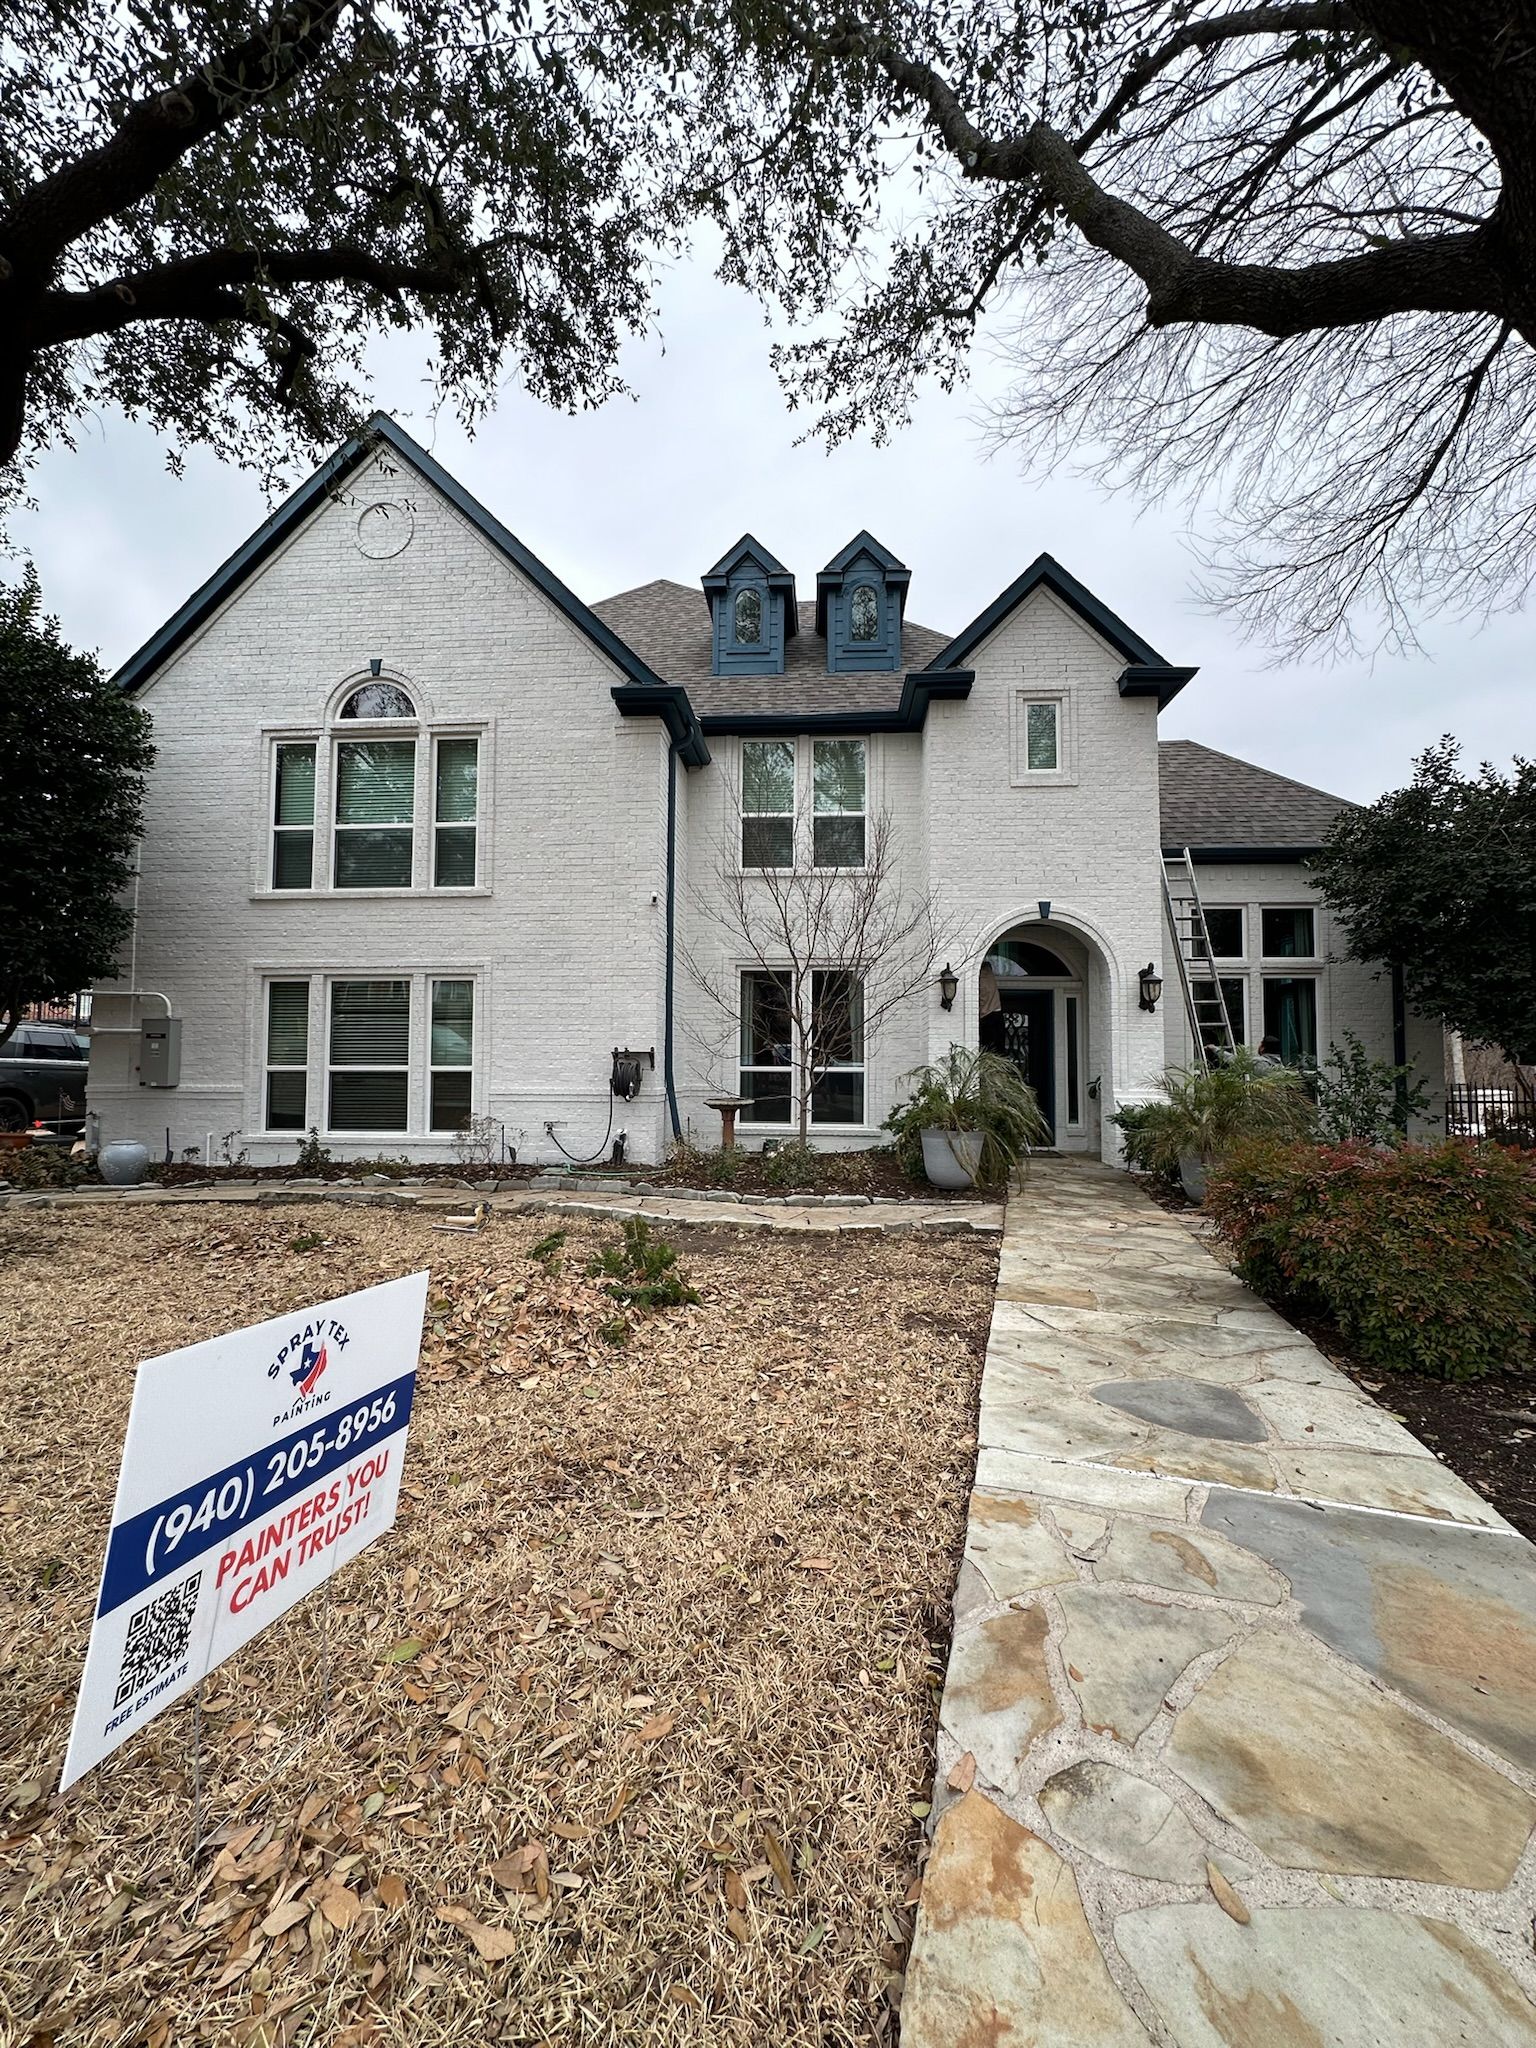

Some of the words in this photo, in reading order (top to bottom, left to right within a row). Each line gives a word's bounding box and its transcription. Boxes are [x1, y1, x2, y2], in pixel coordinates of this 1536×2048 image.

[267, 1319, 326, 1380] SPRAY
[328, 1320, 350, 1352] TEX
[145, 1467, 254, 1576] (940)
[262, 1390, 397, 1496] 205-8956
[215, 1481, 341, 1590] PAINTERS
[346, 1449, 389, 1497] YOU
[229, 1548, 292, 1615] CAN
[298, 1491, 371, 1567] TRUST!
[104, 1704, 133, 1737] FREE
[135, 1661, 189, 1712] ESTIMATE
